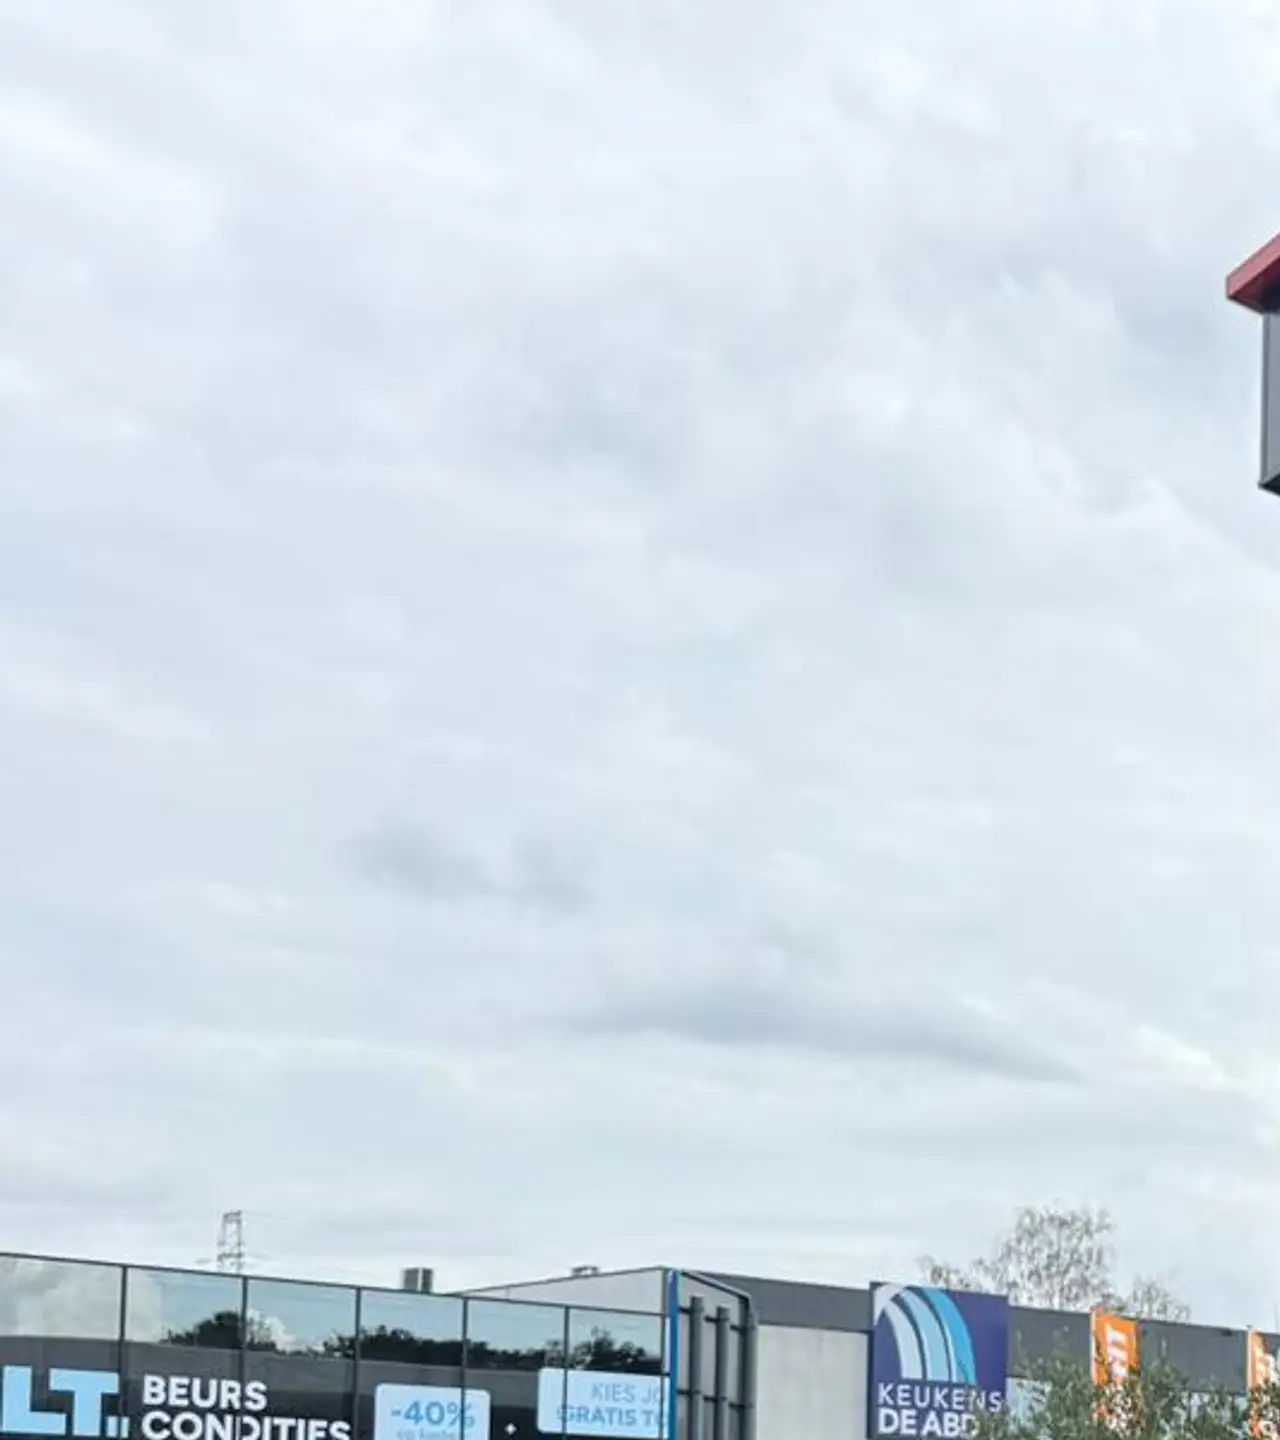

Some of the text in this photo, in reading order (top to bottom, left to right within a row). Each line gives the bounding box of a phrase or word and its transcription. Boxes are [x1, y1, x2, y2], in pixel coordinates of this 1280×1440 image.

[142, 1373, 268, 1412] BEURS
[877, 1382, 1003, 1413] KEUKENS
[390, 1400, 477, 1429] -40%
[878, 1407, 984, 1439] DE ABD
